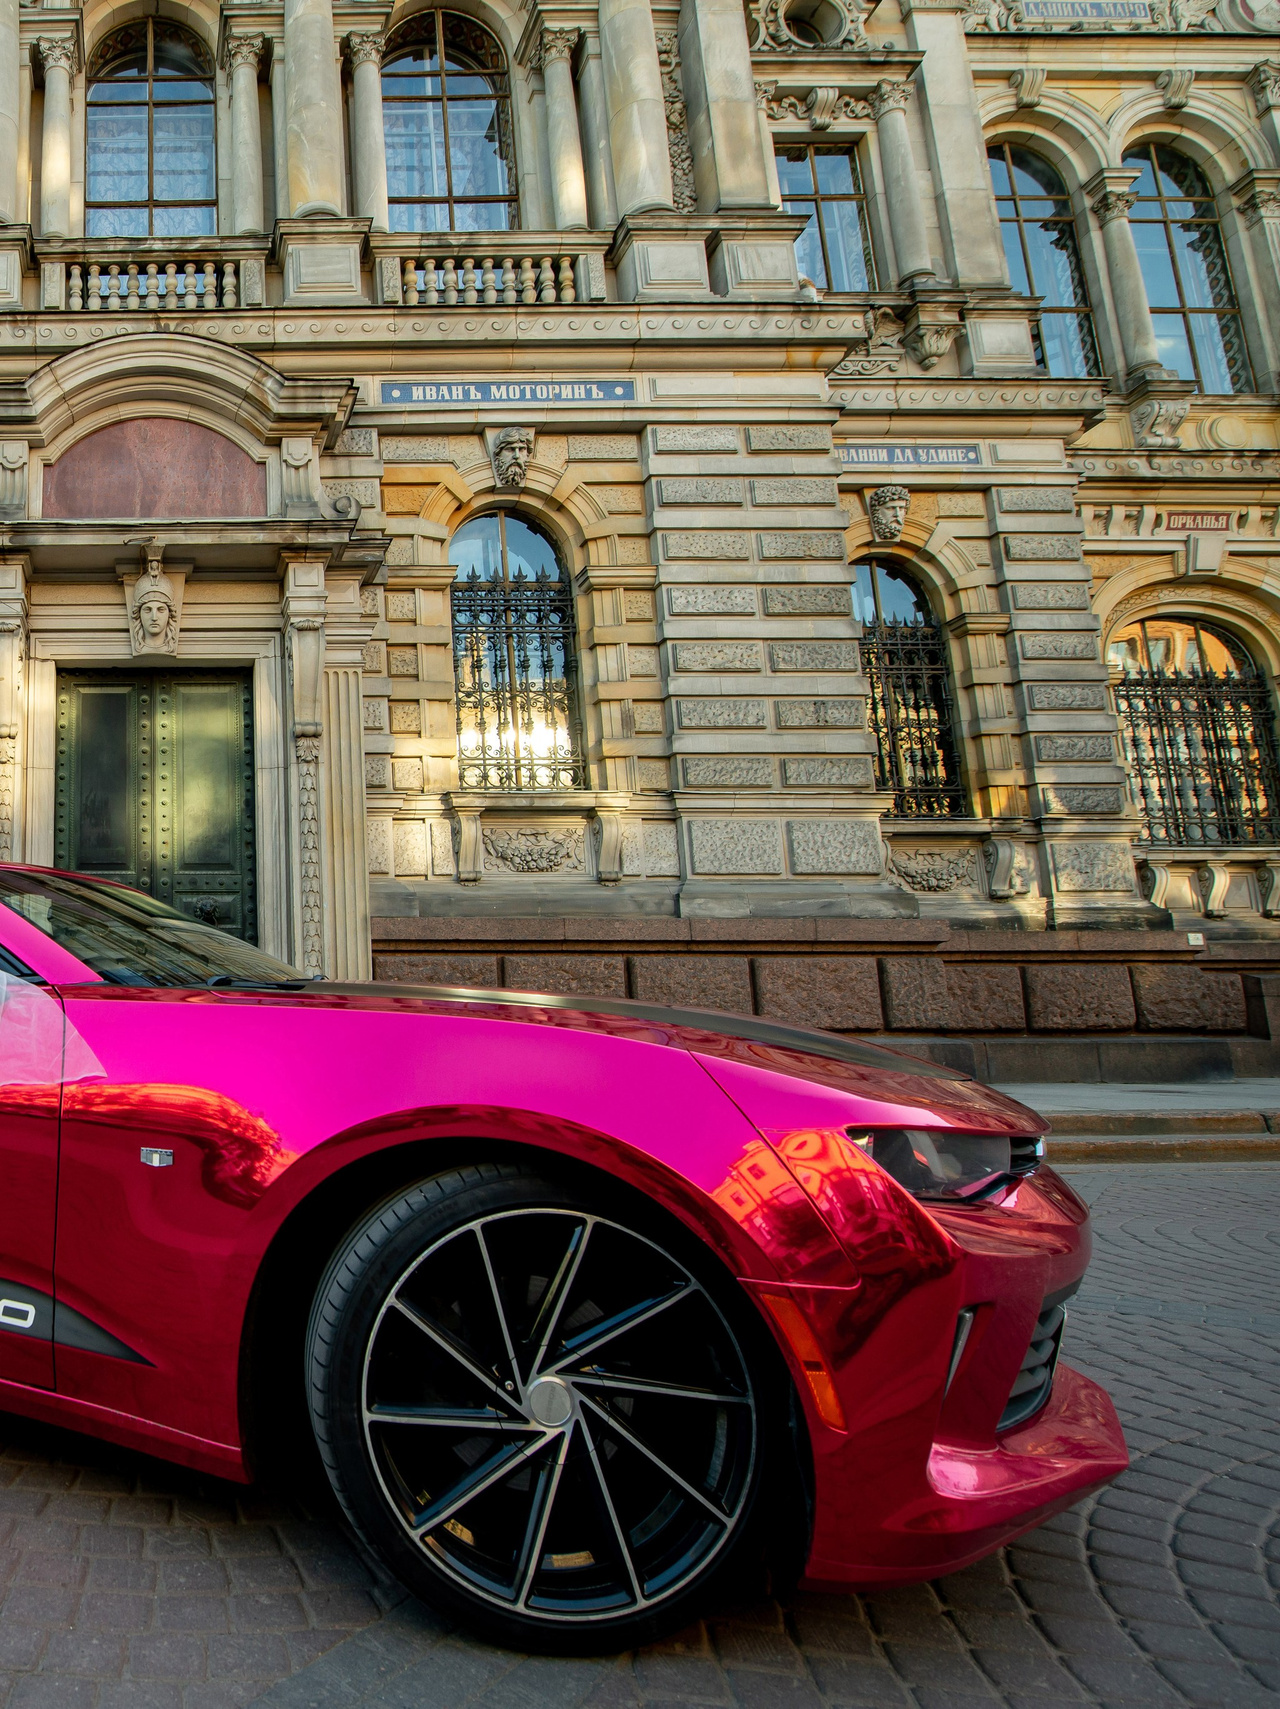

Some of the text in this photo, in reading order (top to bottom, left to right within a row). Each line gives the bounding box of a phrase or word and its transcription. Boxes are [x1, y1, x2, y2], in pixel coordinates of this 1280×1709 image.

[1028, 2, 1097, 17] ДАНИЛЪ
[411, 384, 604, 400] ИВАНЪ МОТОРИНЪ
[893, 448, 915, 463] ДА
[916, 448, 968, 463] УДИНЕ
[1169, 515, 1228, 529] ОРКАНЬЯ
